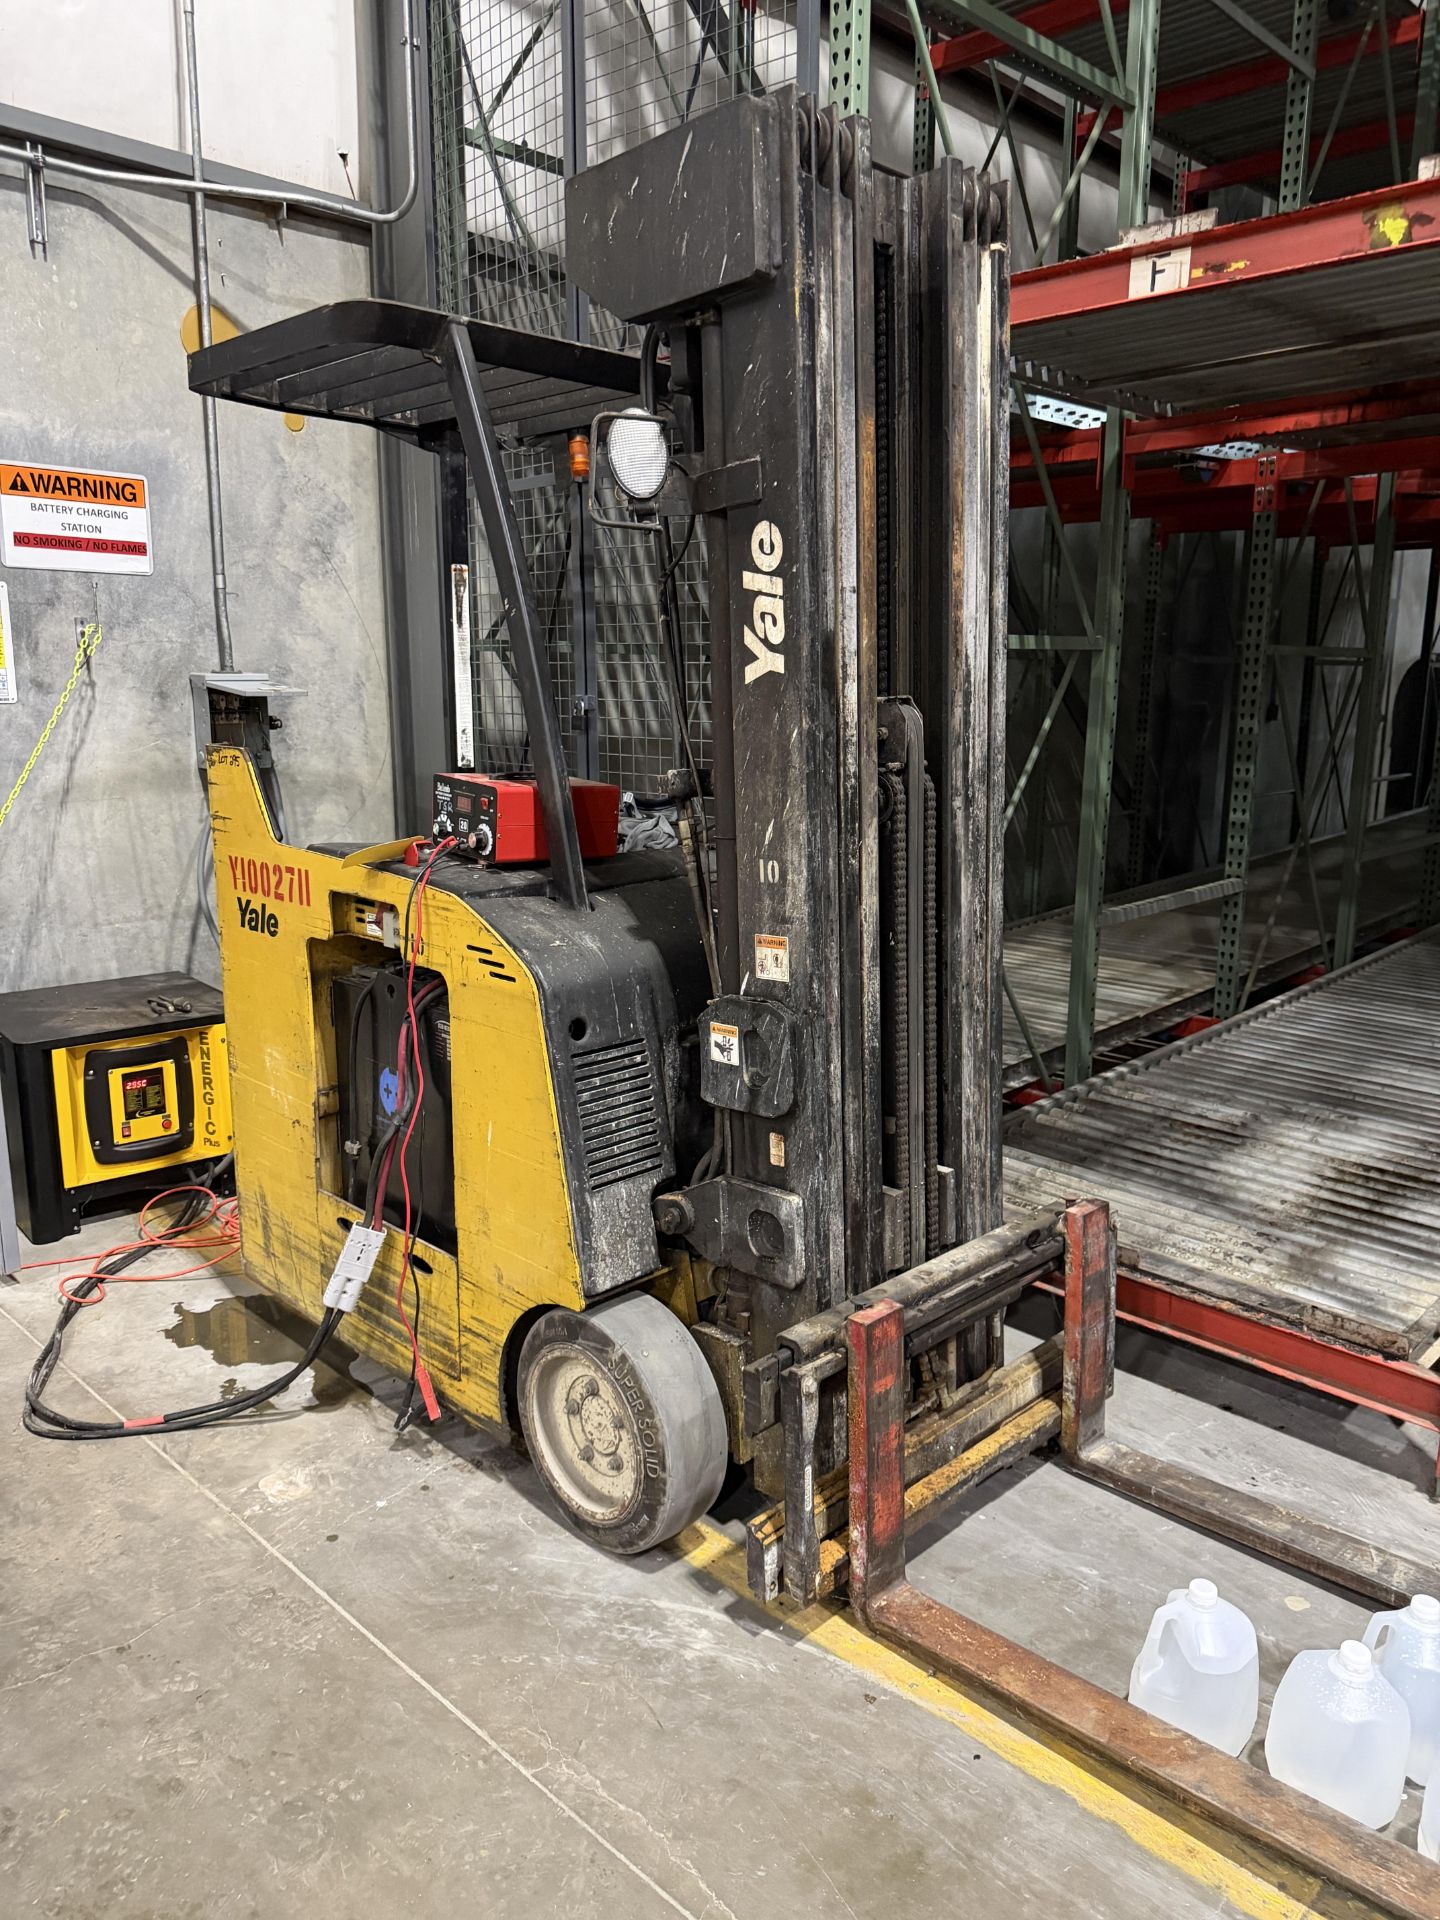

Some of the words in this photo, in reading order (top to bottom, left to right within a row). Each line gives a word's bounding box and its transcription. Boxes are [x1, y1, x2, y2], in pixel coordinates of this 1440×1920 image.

[29, 472, 137, 503] WARNING
[30, 502, 74, 515] BATTERY
[76, 507, 129, 520] CHARGING
[60, 522, 102, 534] STATION
[14, 534, 31, 546] NO
[33, 536, 83, 549] SMOKING
[93, 542, 108, 552] NO
[110, 544, 147, 554] FLAMES
[742, 519, 786, 685] Yale
[758, 857, 780, 884] 10
[236, 896, 279, 938] Yale
[199, 1031, 217, 1136] ENERGIC
[203, 1137, 221, 1148] Plus
[606, 1356, 645, 1414] SUPER
[638, 1417, 660, 1479] SOLID
